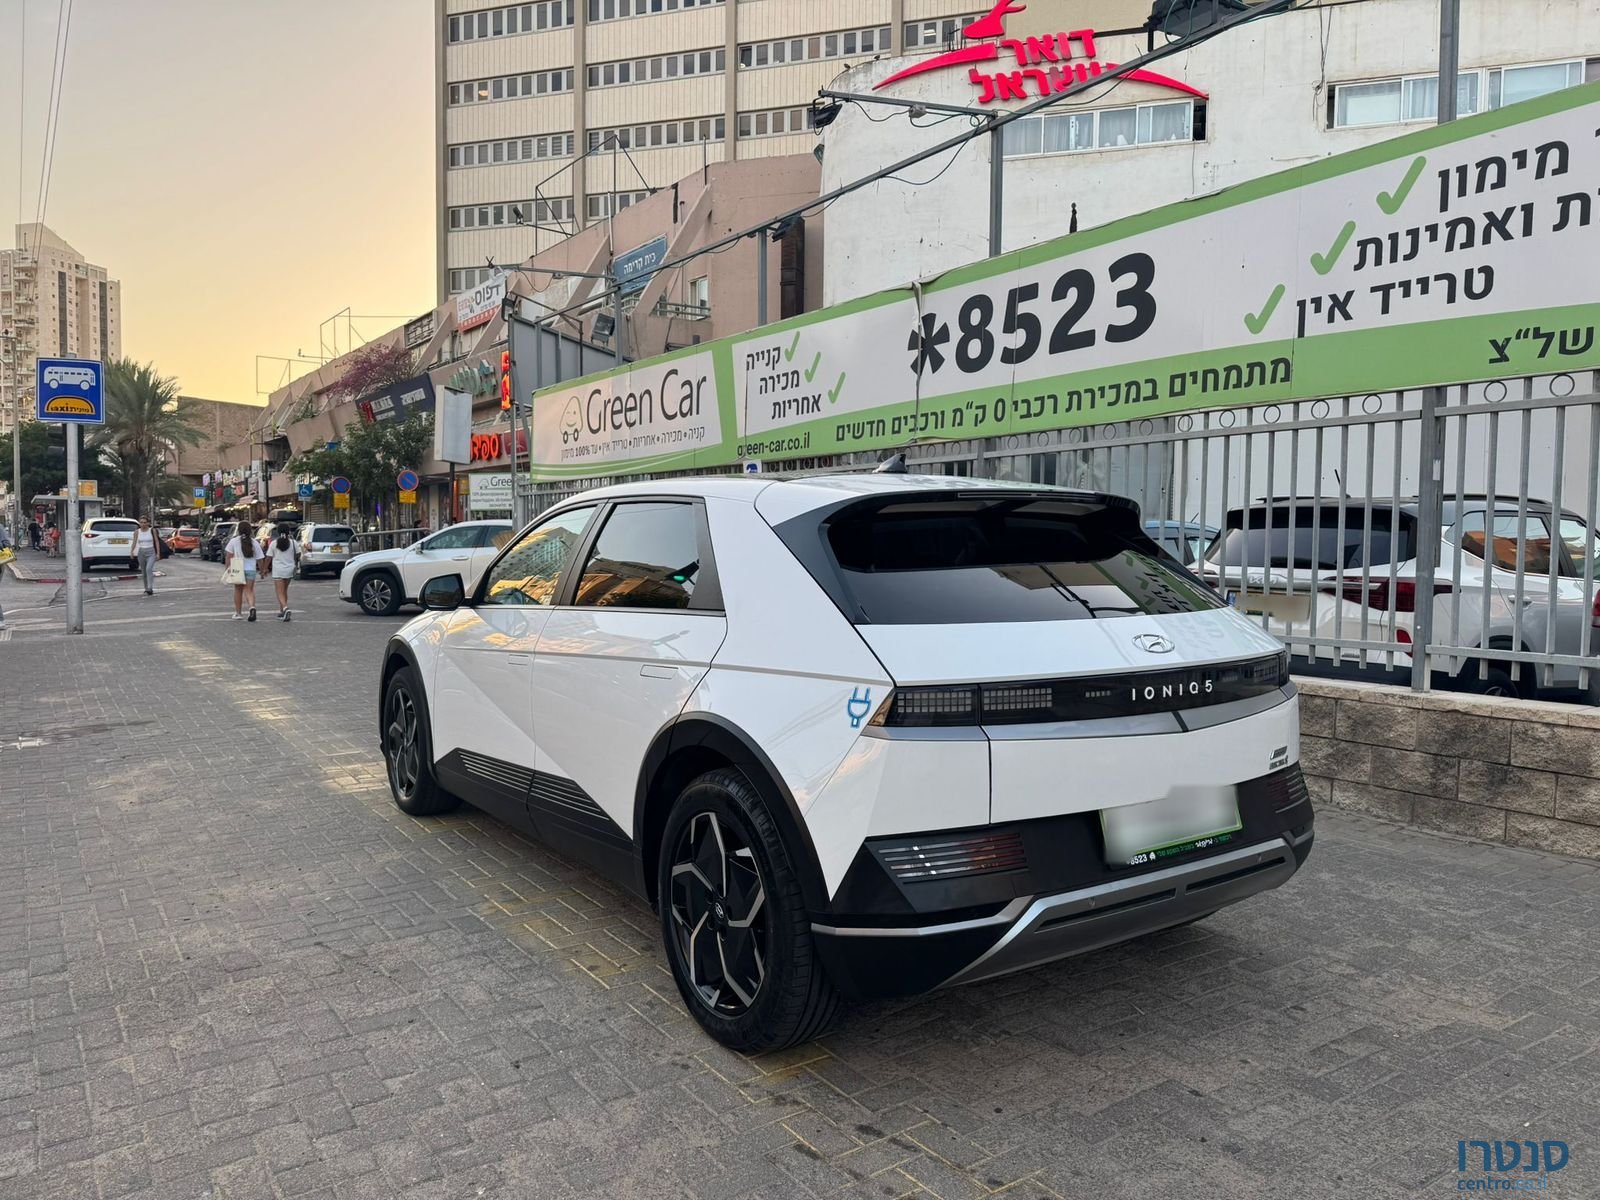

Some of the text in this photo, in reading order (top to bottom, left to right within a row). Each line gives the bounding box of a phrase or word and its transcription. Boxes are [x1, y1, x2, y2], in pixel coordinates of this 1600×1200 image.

[1000, 28, 1096, 66] דואר
[968, 61, 1102, 103] ישראל
[1438, 140, 1570, 213] מימון
[1354, 188, 1600, 271] ת ואמינות
[623, 257, 643, 275] קדימה
[1296, 264, 1495, 338] טרייד אין
[746, 346, 781, 371] קנייה
[759, 370, 800, 395] מכירה
[1169, 357, 1292, 398] מתמחים
[587, 368, 707, 434] Green Car
[771, 393, 822, 420] אחריות
[1012, 393, 1058, 420] רכבי
[1065, 377, 1159, 414] במכירת
[993, 397, 1006, 422] 0
[688, 426, 705, 442] קניה
[836, 418, 886, 441] חדשים
[891, 410, 945, 435] ורכבים
[632, 434, 656, 449] אחריות
[660, 429, 682, 444] מכירה
[575, 445, 590, 457] 100%
[490, 476, 513, 487] Gree
